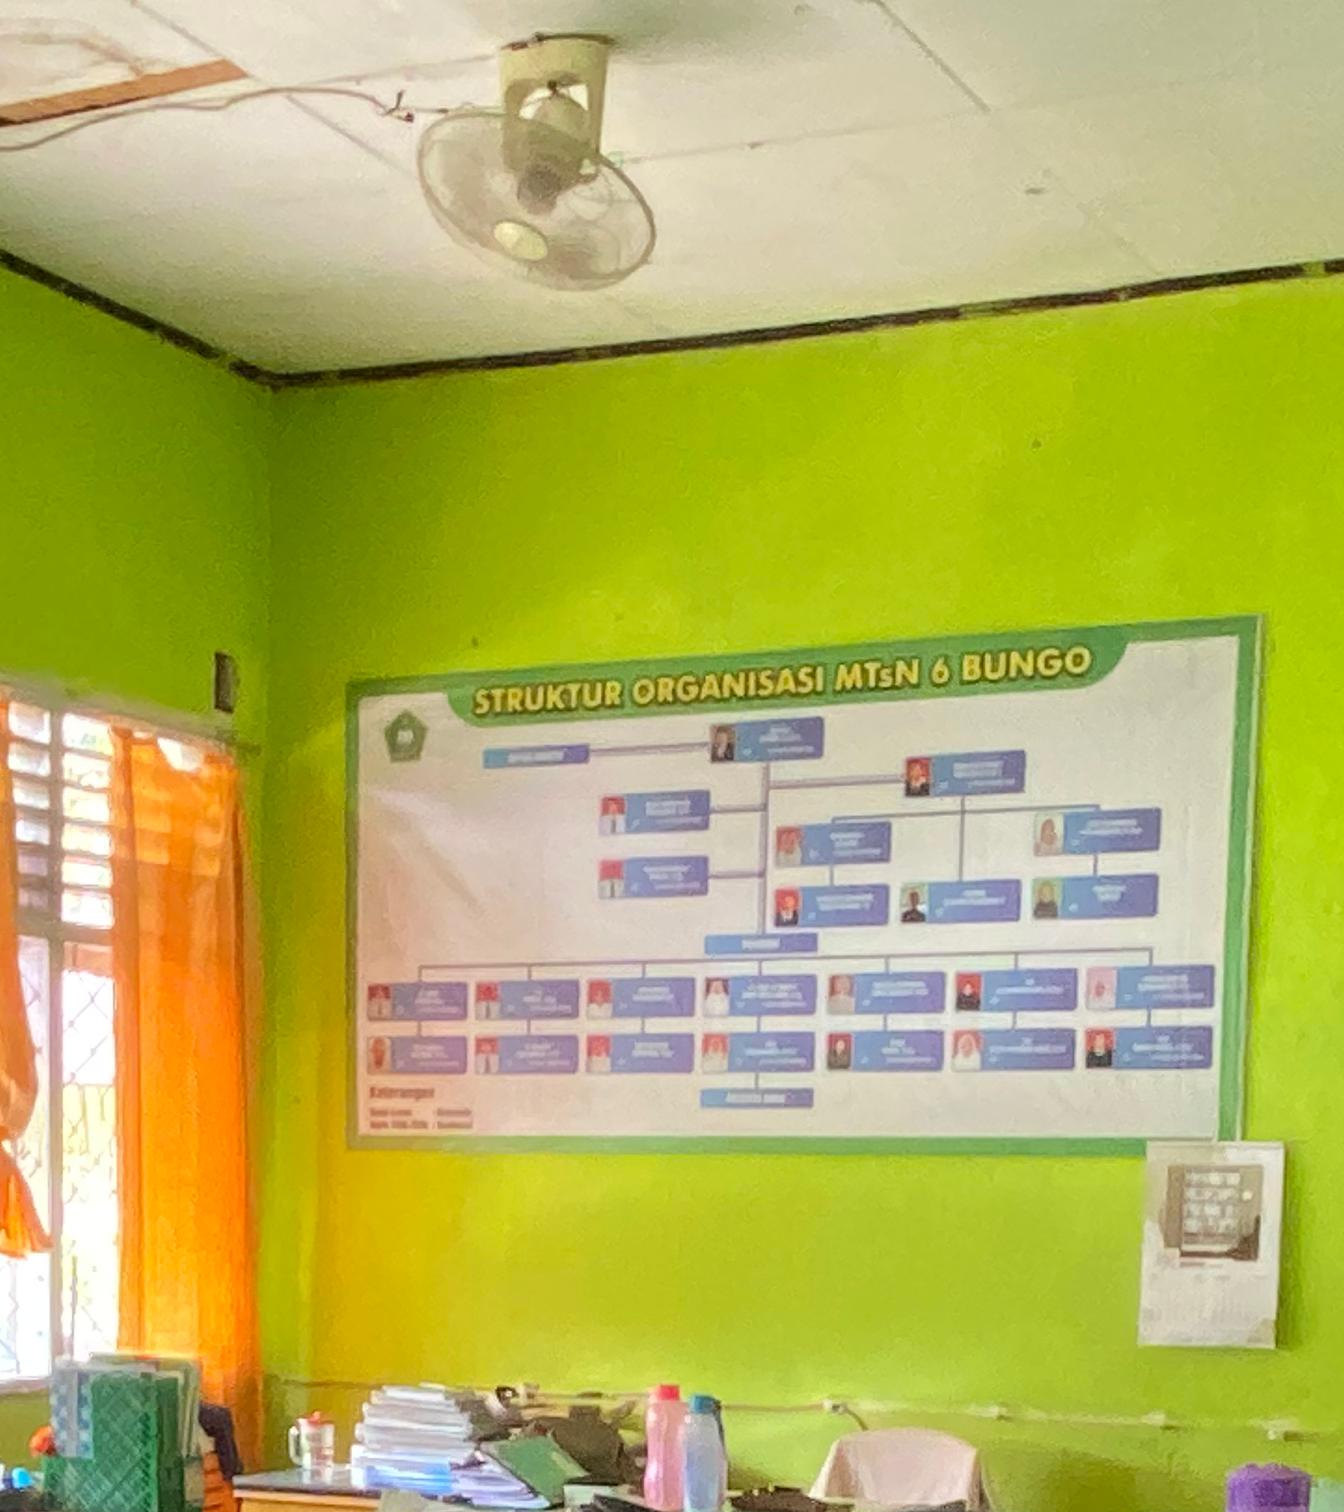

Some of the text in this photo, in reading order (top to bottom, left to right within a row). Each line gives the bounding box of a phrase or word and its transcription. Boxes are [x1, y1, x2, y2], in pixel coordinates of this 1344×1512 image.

[473, 646, 1094, 716] STRUKTUR ORGANISASI MTsN 6 BUNGO
